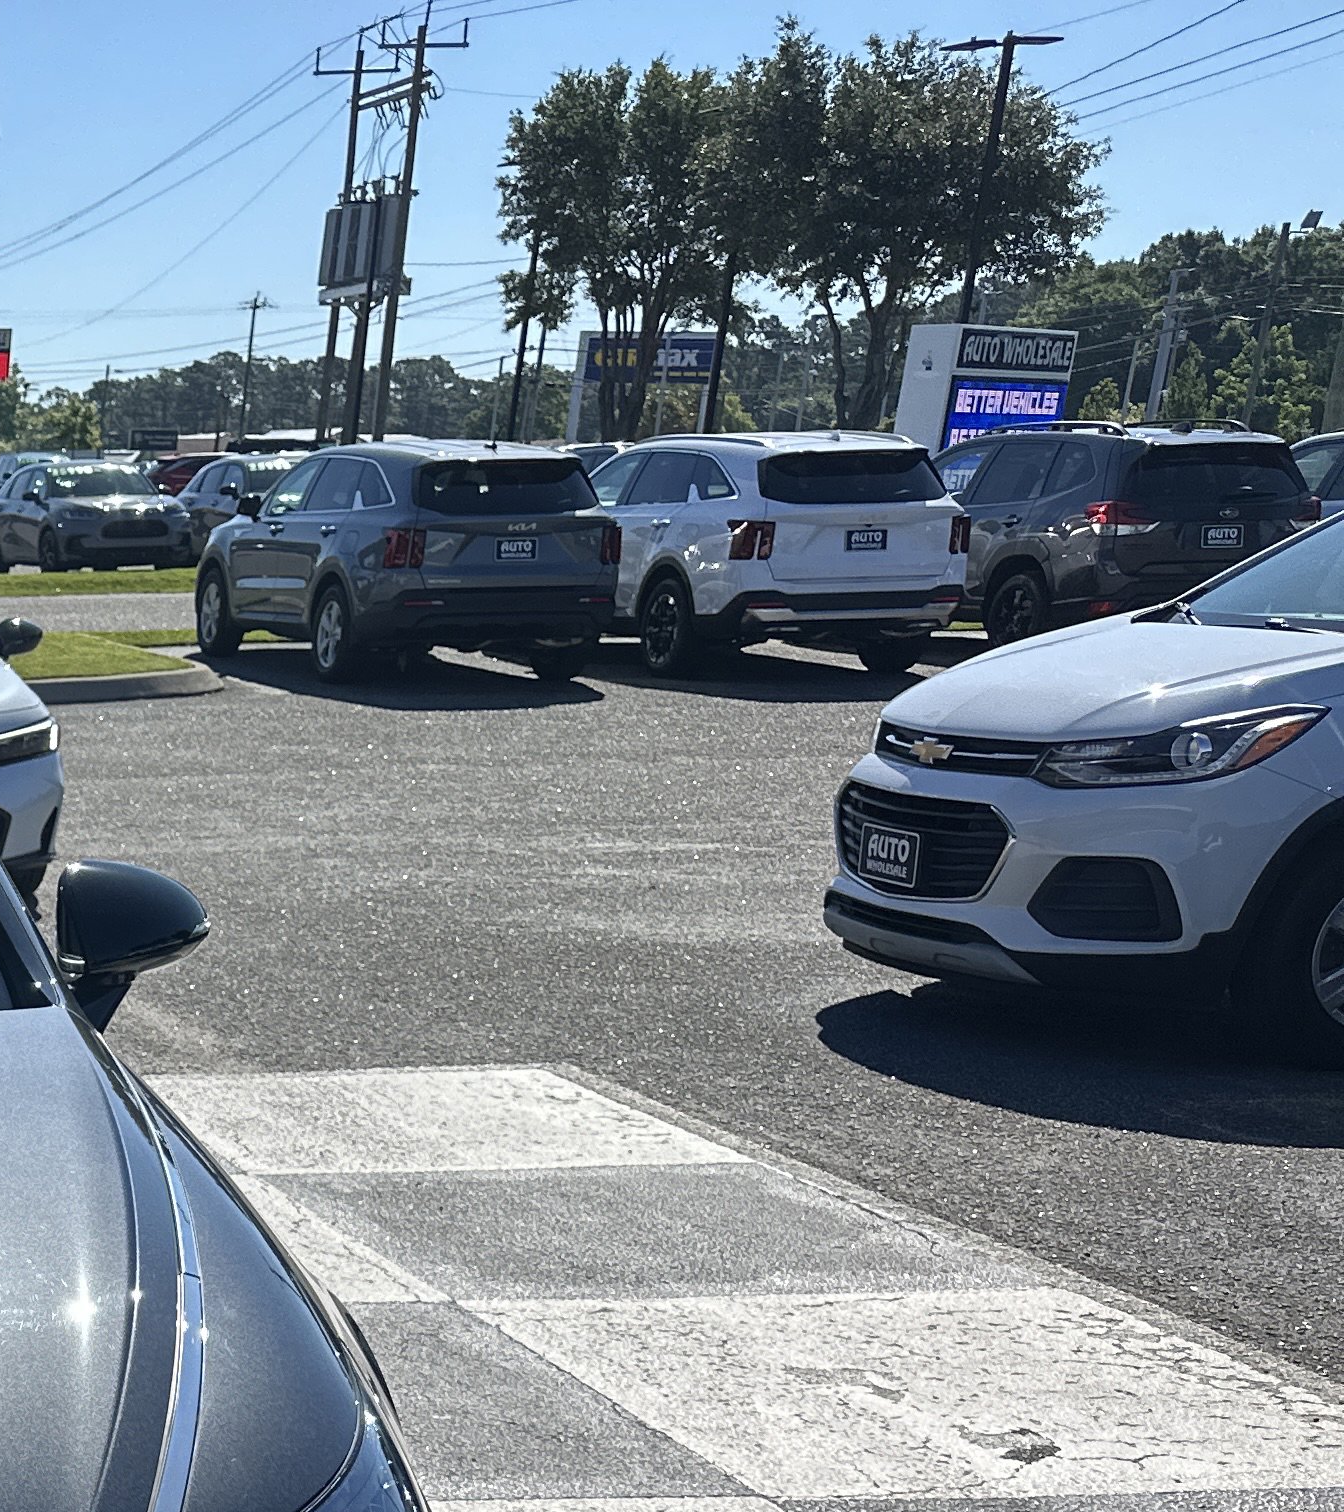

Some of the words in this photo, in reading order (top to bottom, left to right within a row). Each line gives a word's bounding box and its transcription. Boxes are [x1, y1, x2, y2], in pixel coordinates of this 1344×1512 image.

[963, 335, 1001, 363] AUTO
[1002, 337, 1073, 367] WHOLESALE
[954, 388, 1004, 414] BETTER
[1002, 390, 1060, 415] VEHICLES
[851, 531, 883, 544] AUTO
[1208, 528, 1238, 540] AUTO
[501, 541, 532, 553] AUTO
[868, 834, 909, 862] AUTO
[867, 859, 907, 878] WHOLESALE
